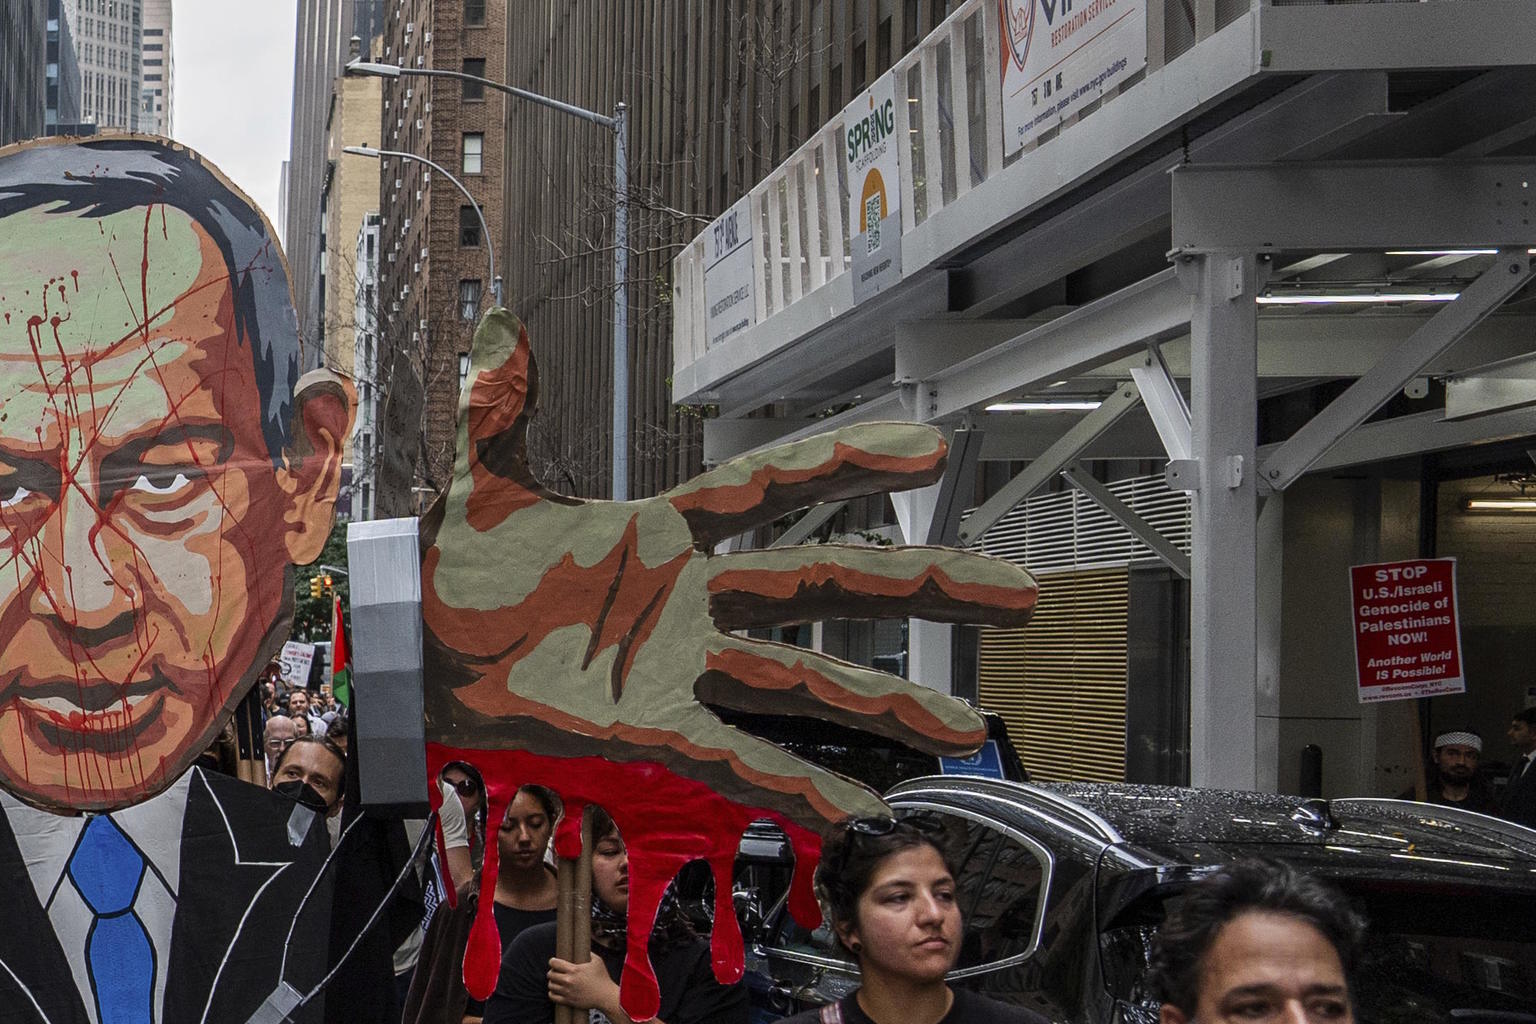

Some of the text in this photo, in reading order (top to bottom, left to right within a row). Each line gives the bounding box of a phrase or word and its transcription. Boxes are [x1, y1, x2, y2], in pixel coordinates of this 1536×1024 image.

[1050, 9, 1088, 48] RESTORATION
[855, 141, 888, 173] SCAFFOLDING
[1375, 565, 1428, 582] STOP
[1362, 581, 1443, 600] U.S./Israeli
[1359, 596, 1449, 617] Genocide of
[1359, 615, 1451, 634] Palestinians
[1387, 631, 1428, 646] NOW!
[1367, 649, 1453, 668] Another World
[1375, 664, 1446, 681] IS Possible!
